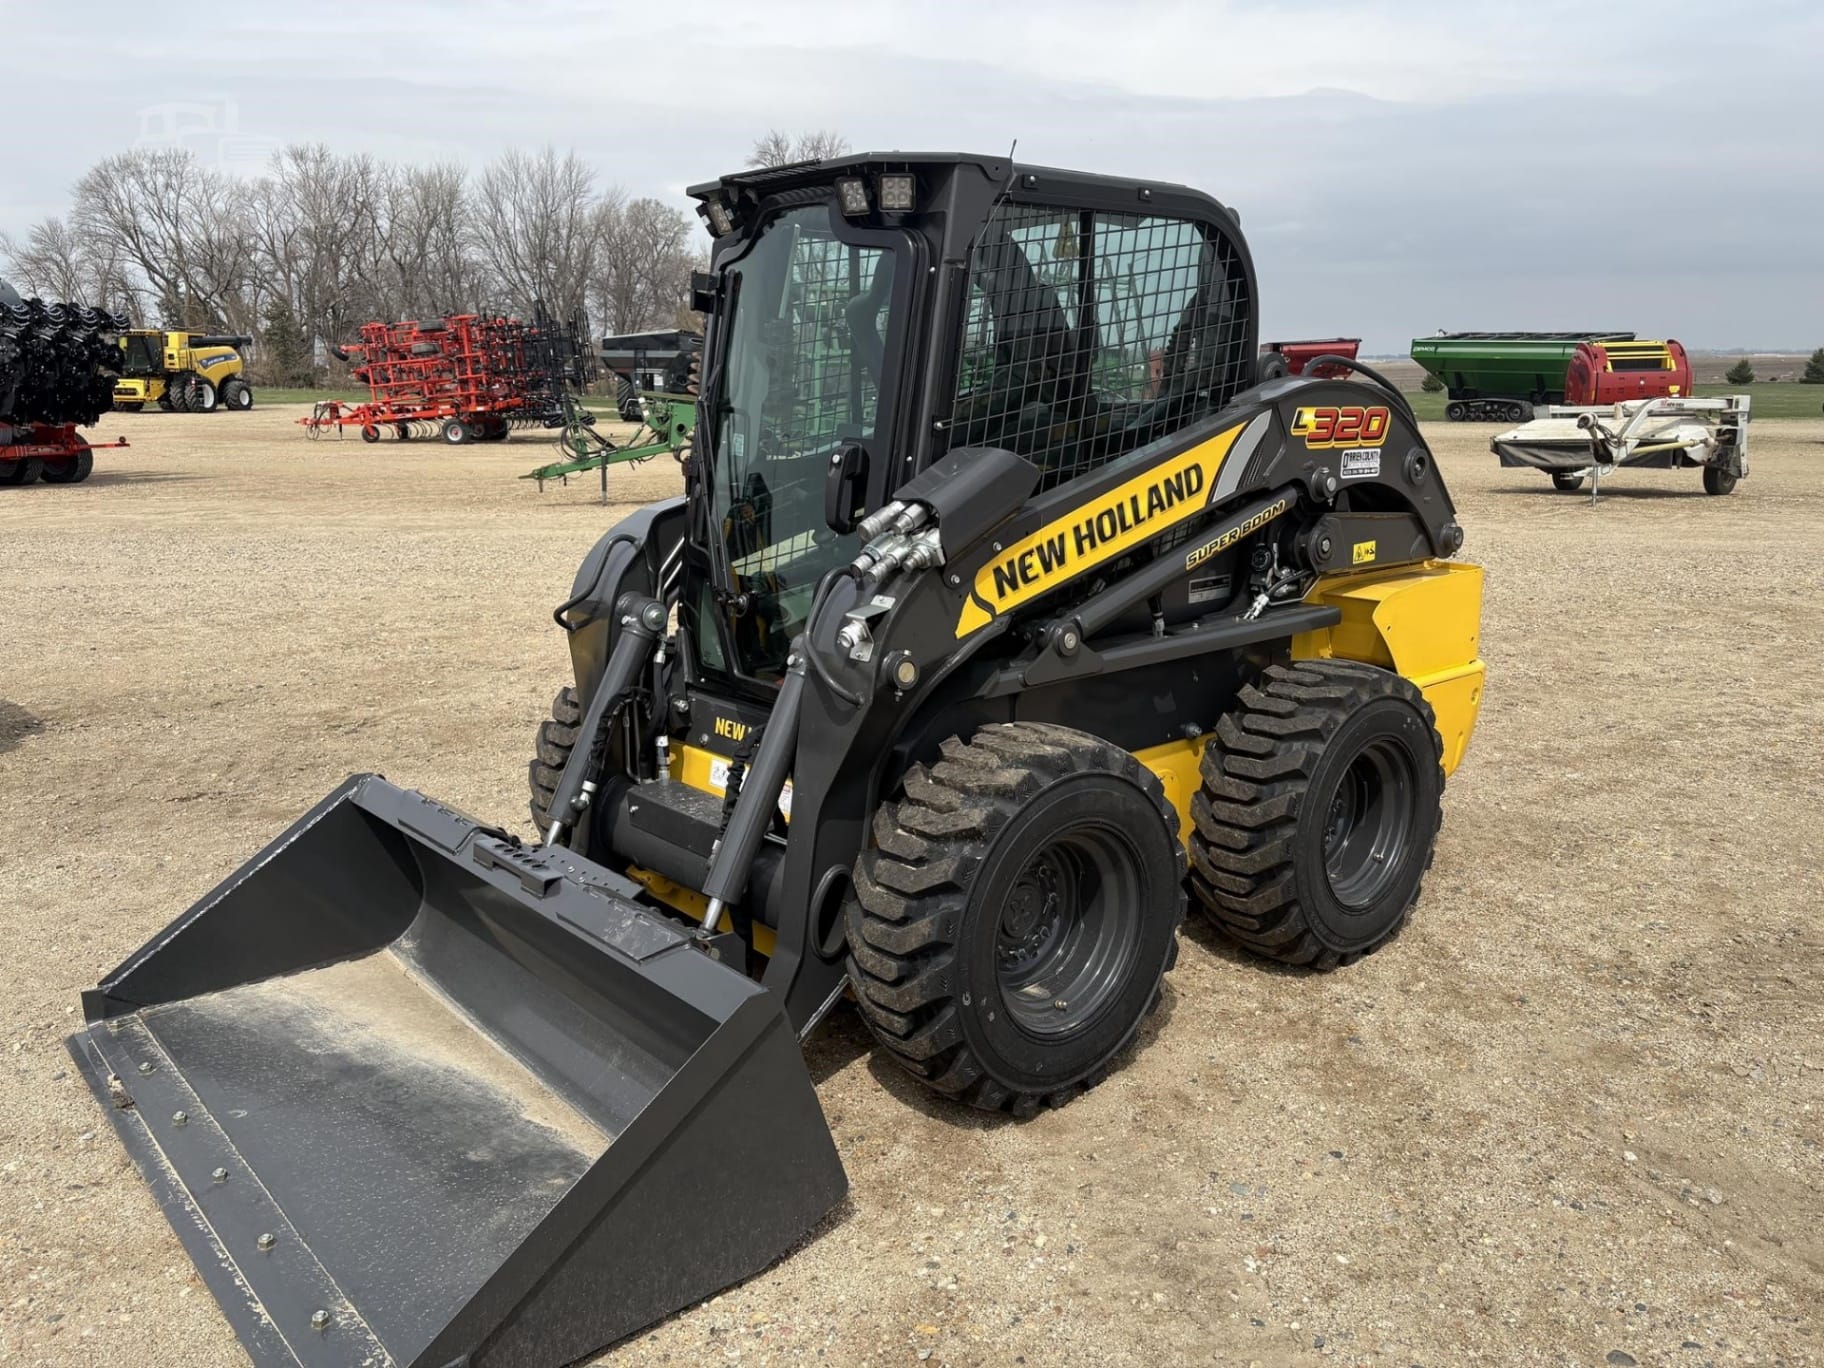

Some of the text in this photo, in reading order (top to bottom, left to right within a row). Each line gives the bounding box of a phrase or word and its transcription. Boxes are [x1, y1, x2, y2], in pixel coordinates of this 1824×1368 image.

[1291, 407, 1391, 449] L320
[992, 463, 1204, 598] NEW HOLLAND
[1186, 499, 1286, 571] SUPER BOOM
[715, 717, 746, 741] NEW
